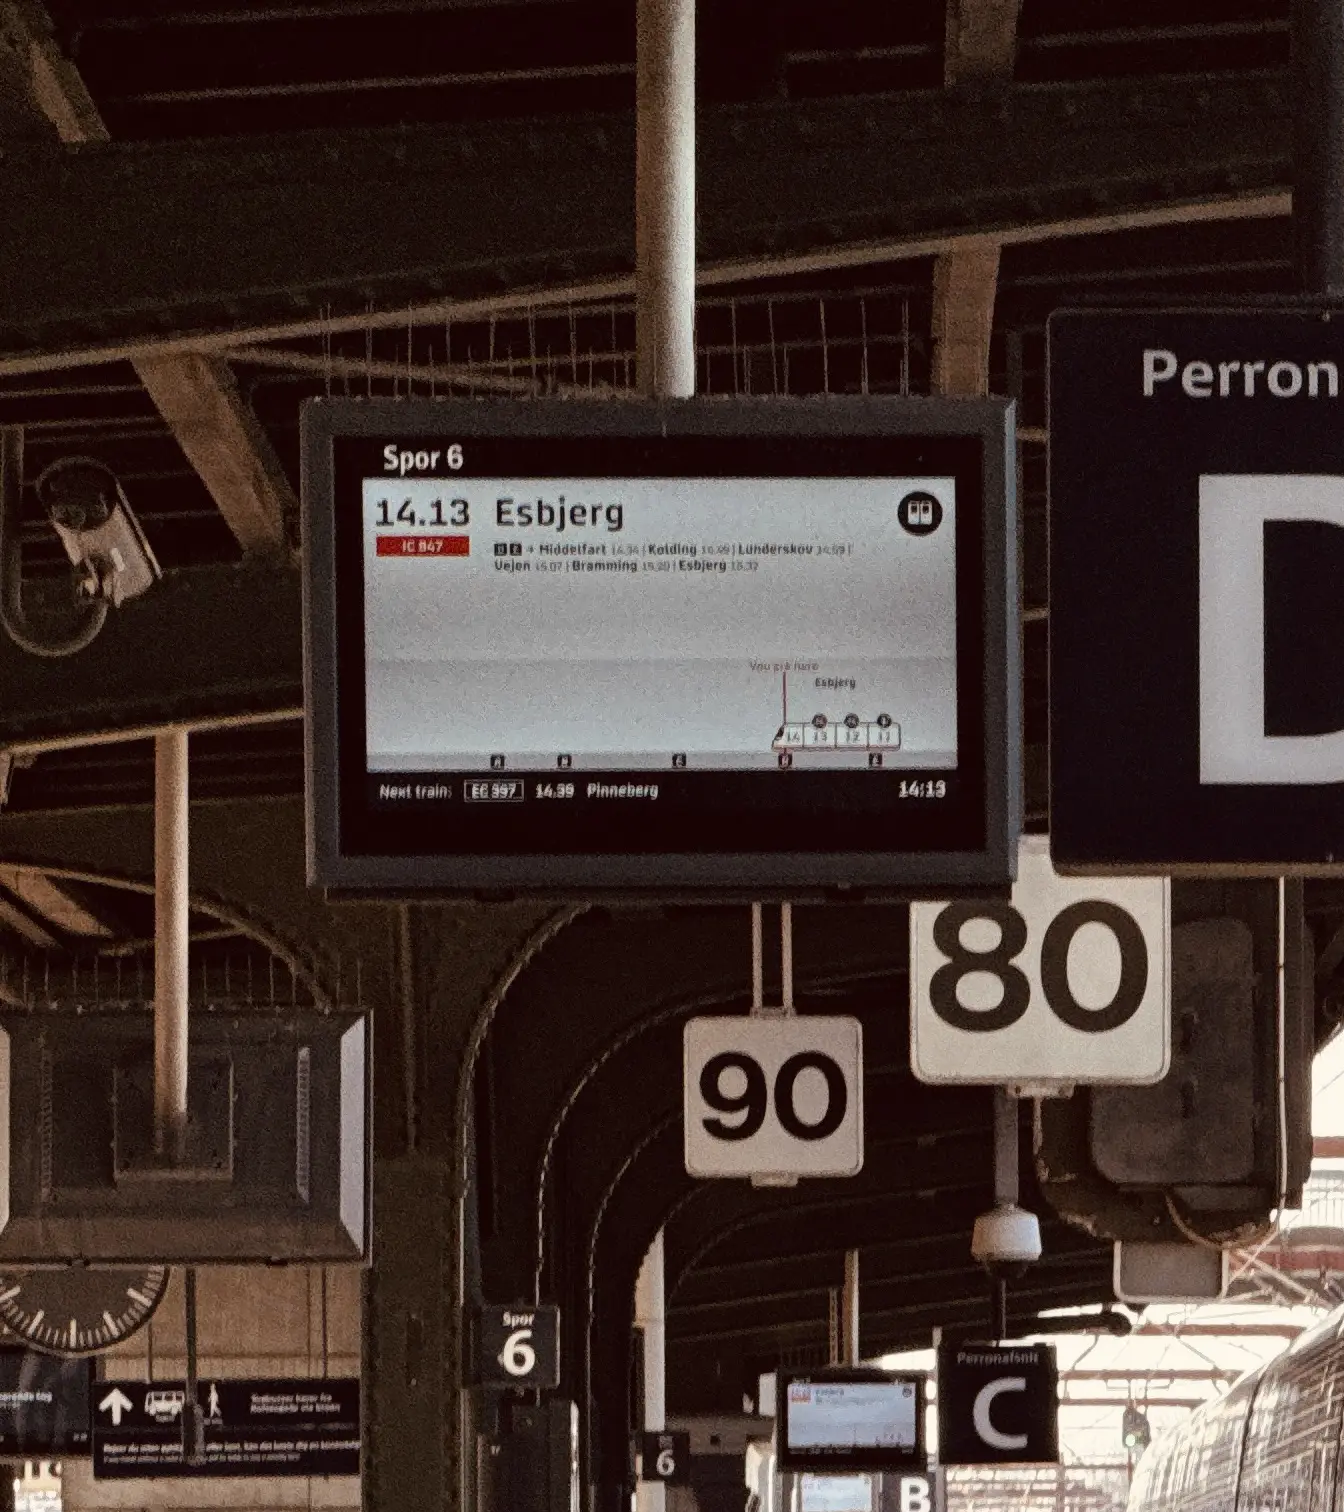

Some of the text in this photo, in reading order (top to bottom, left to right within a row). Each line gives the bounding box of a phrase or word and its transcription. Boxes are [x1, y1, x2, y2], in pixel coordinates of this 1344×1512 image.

[383, 444, 463, 475] Spor 6
[375, 497, 624, 532] 14.13 Esbjerg
[539, 542, 606, 556] Middelfart
[649, 542, 697, 557] Kolding
[494, 559, 531, 572] Vejen
[572, 560, 637, 572] Bramming
[679, 559, 727, 573] Esbjerg
[379, 783, 412, 799] Next
[587, 782, 659, 800] Pinneberg
[928, 899, 1149, 1032] 80
[699, 1051, 848, 1141] 90
[503, 1311, 535, 1329] Spor
[503, 1329, 536, 1376] 6
[973, 1377, 1028, 1450] C
[656, 1450, 675, 1476] 6
